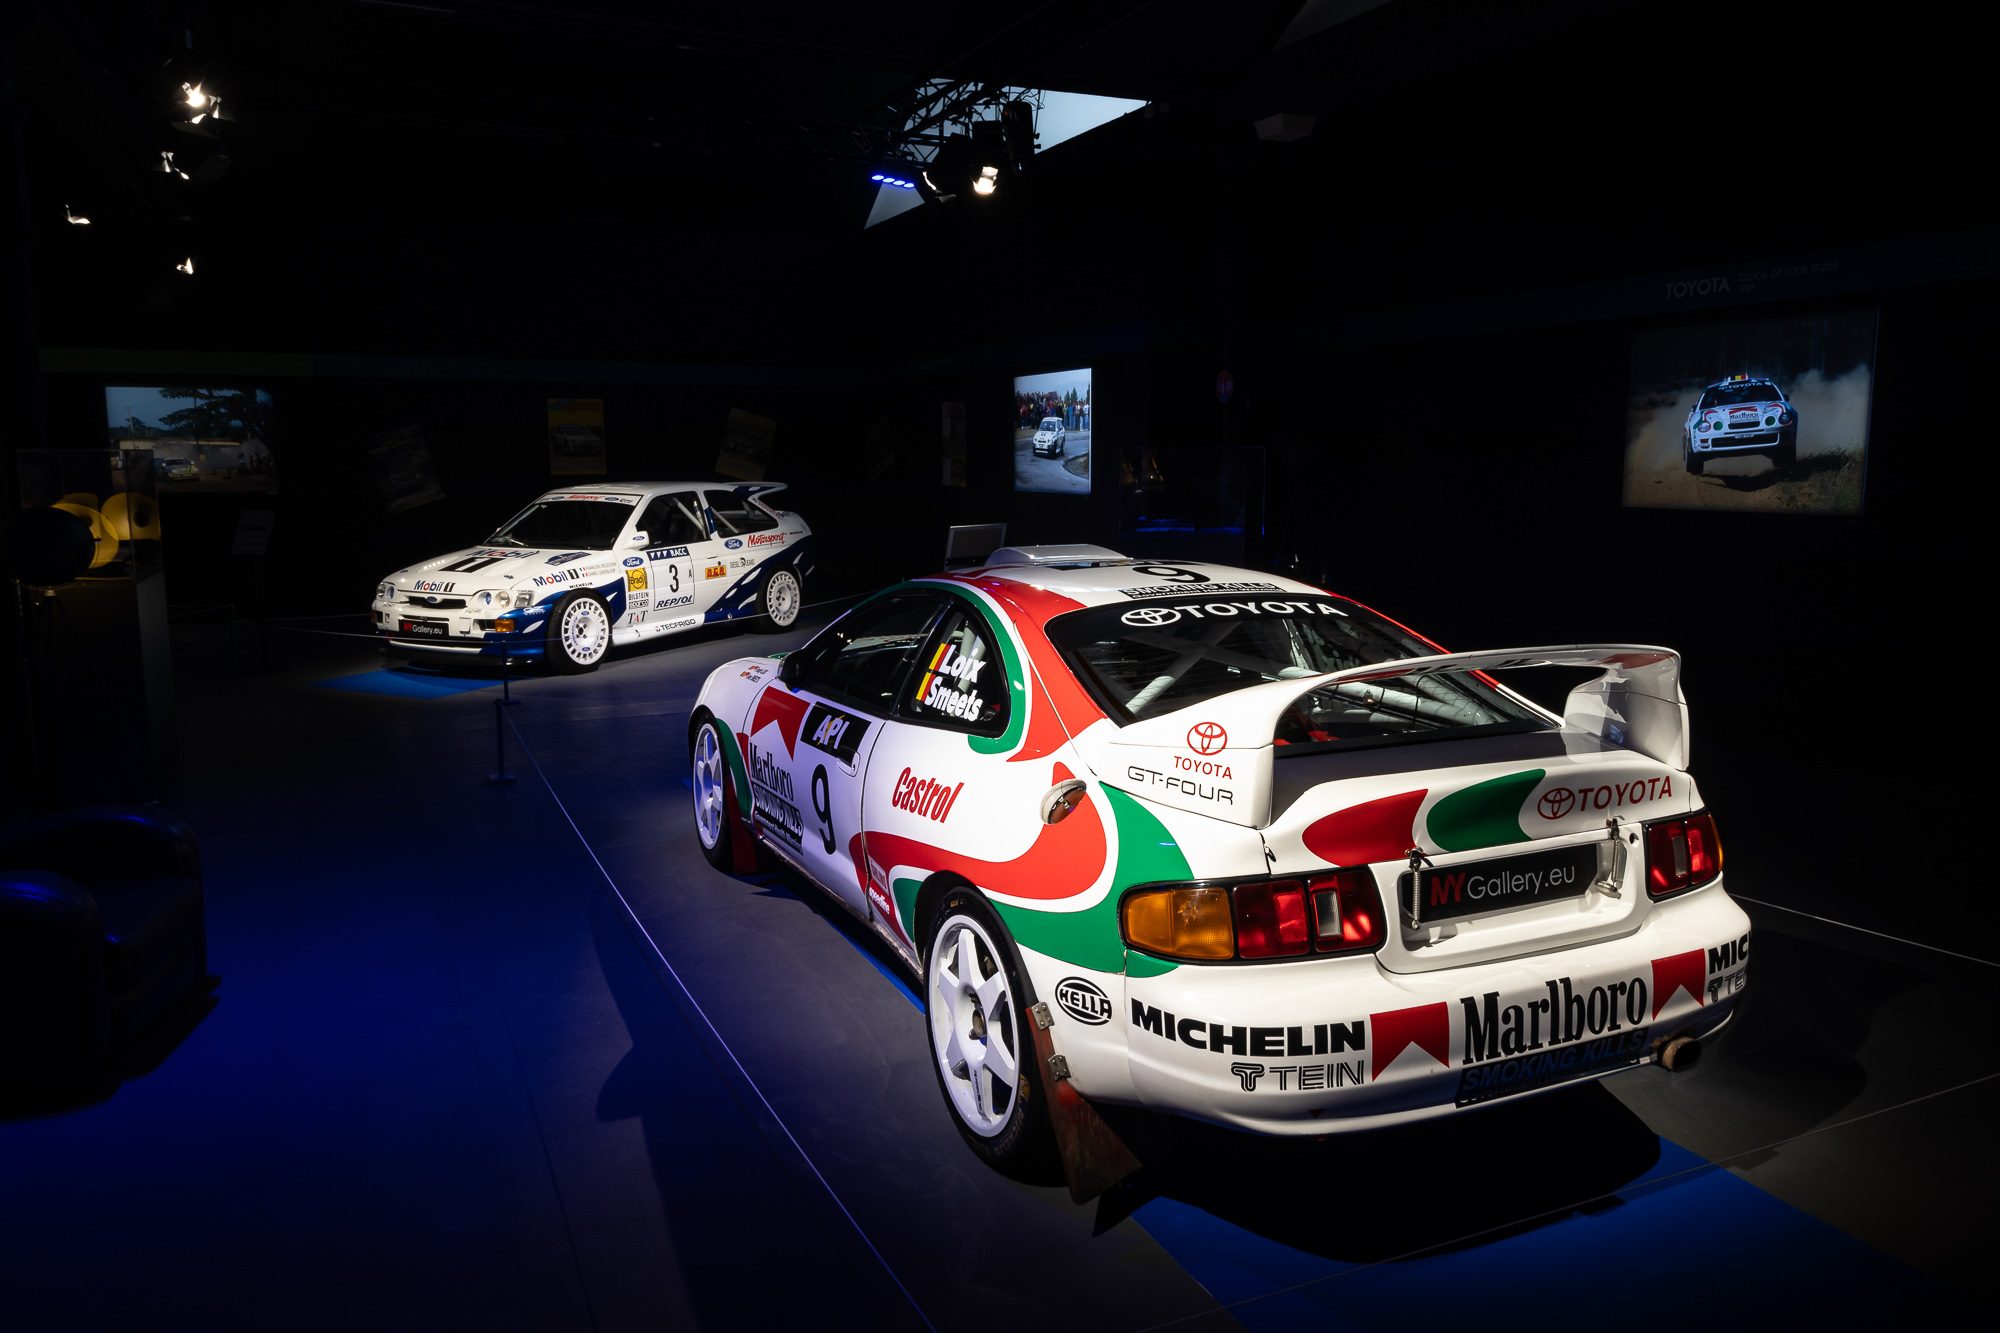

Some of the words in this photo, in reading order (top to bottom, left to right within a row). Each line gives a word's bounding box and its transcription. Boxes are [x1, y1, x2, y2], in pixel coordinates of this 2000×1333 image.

[1665, 276, 1730, 299] TOYOTA
[670, 548, 687, 557] RACC
[748, 533, 784, 548] Motorsport
[625, 557, 642, 567] Ford
[1132, 566, 1211, 583] 9
[414, 580, 443, 592] Mobil
[532, 571, 569, 587] Mobil
[669, 564, 680, 593] 3
[1122, 583, 1219, 595] SMOKING
[655, 595, 694, 608] REPSOL
[1174, 601, 1349, 619] TOYOTA
[660, 619, 697, 631] TECFRIGO
[938, 644, 986, 683] Loix
[924, 676, 984, 722] Smeets
[749, 742, 794, 802] Marlboro
[1173, 755, 1233, 780] TOYOTA
[891, 766, 965, 824] Castrol
[1127, 765, 1234, 805] GT-FOUR
[1578, 776, 1673, 811] TOYOTA
[811, 764, 836, 855] 9
[1708, 930, 1752, 974] MIC
[1057, 986, 1113, 1020] HELLA
[1131, 998, 1366, 1057] MICHELIN
[1459, 976, 1648, 1066] Marlboro
[1269, 1060, 1365, 1091] TEIN
[1462, 1048, 1577, 1091] SMOKING
[1581, 1030, 1649, 1064] KILLS
